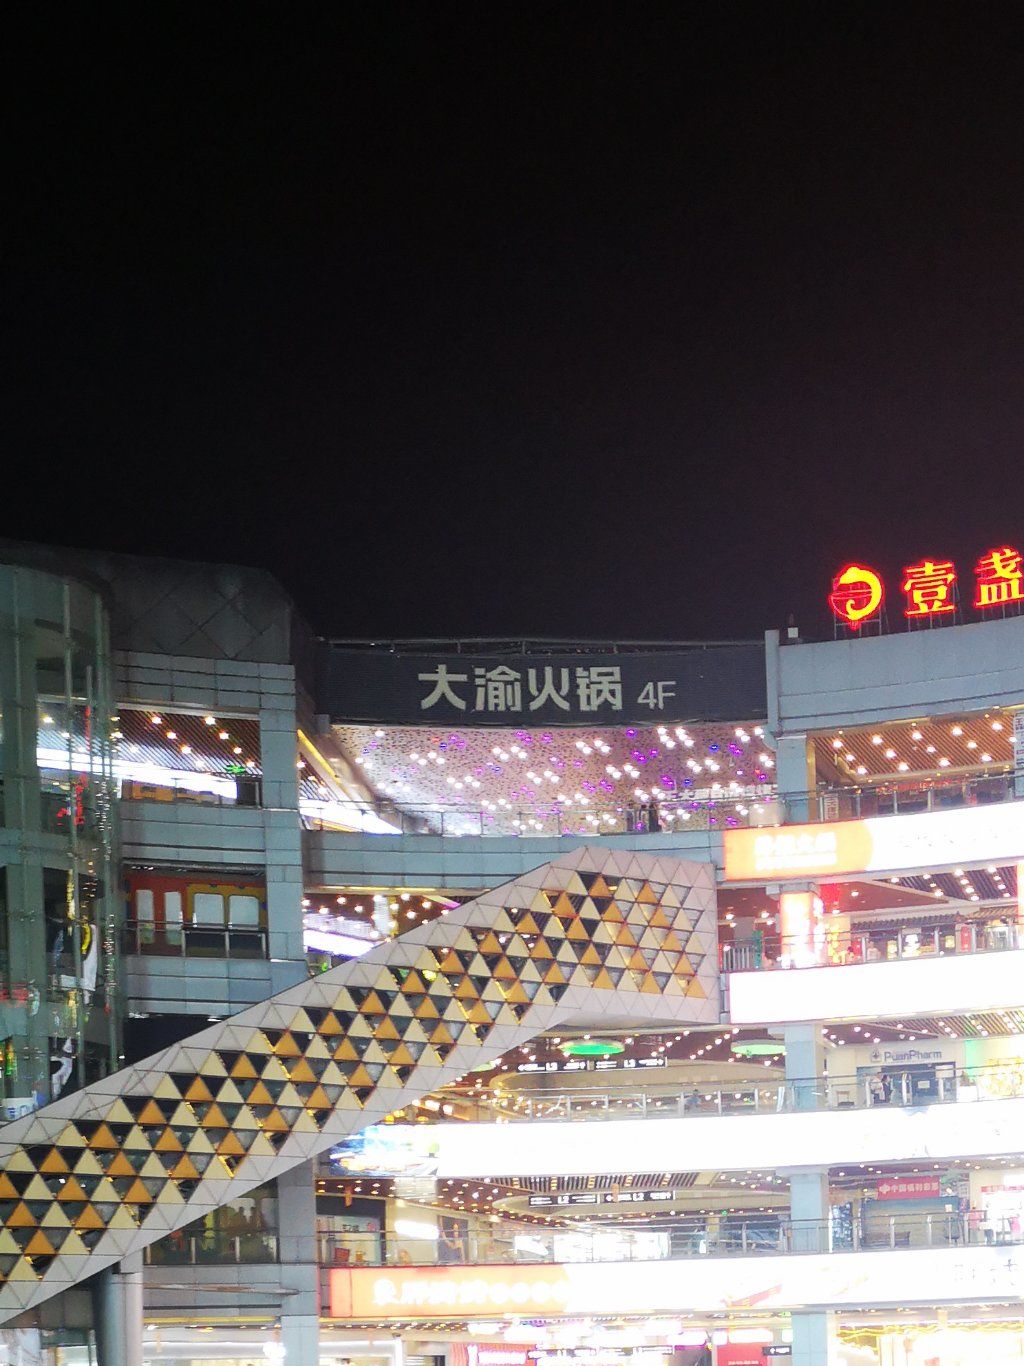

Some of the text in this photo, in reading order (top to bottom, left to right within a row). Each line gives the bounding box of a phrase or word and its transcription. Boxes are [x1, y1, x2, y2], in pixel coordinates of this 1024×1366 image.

[418, 664, 678, 712] 大渝火锅 4F
